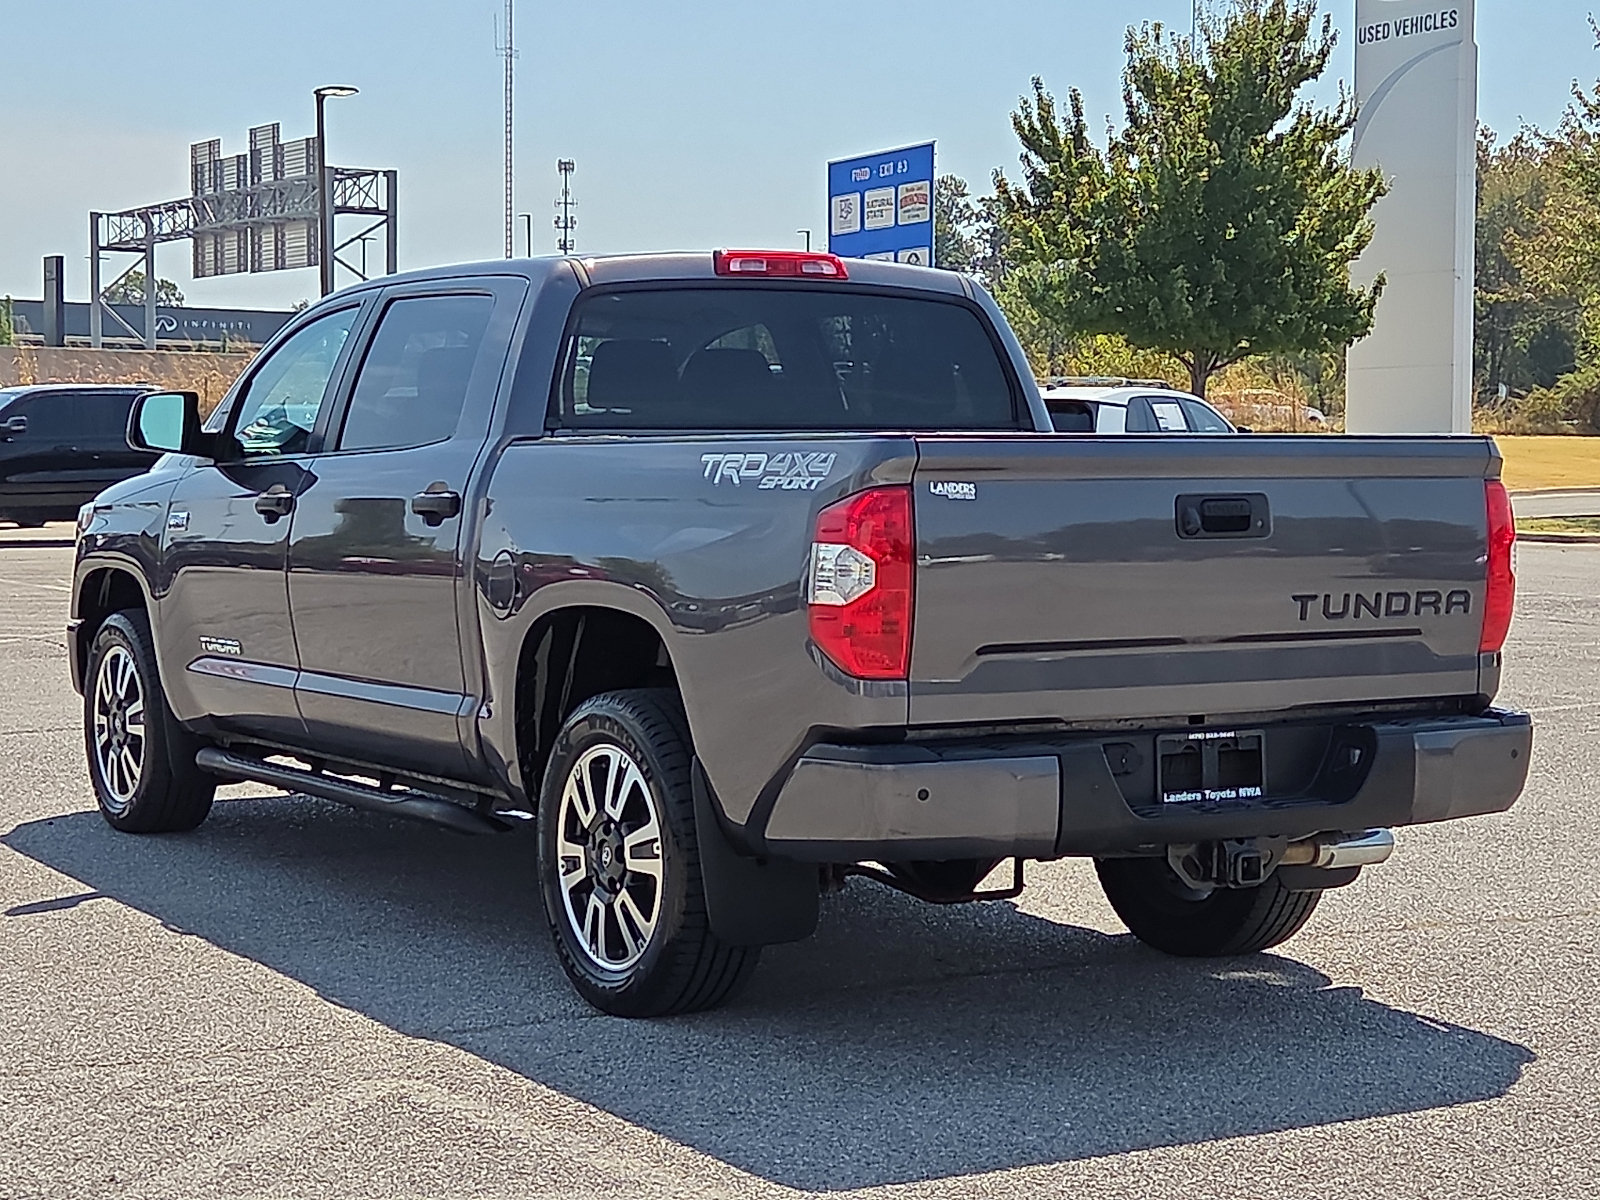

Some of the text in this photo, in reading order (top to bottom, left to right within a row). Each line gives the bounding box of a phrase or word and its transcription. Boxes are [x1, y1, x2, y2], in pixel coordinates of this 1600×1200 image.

[1359, 9, 1458, 44] USED VEHICLES
[183, 320, 251, 330] INFINITI
[701, 452, 837, 485] TRD 4X4
[758, 476, 826, 490] SPORT
[929, 481, 976, 494] LANDERS
[1291, 590, 1471, 621] TUNDRA
[1163, 791, 1202, 803] Landers
[1204, 789, 1236, 801] Toyota
